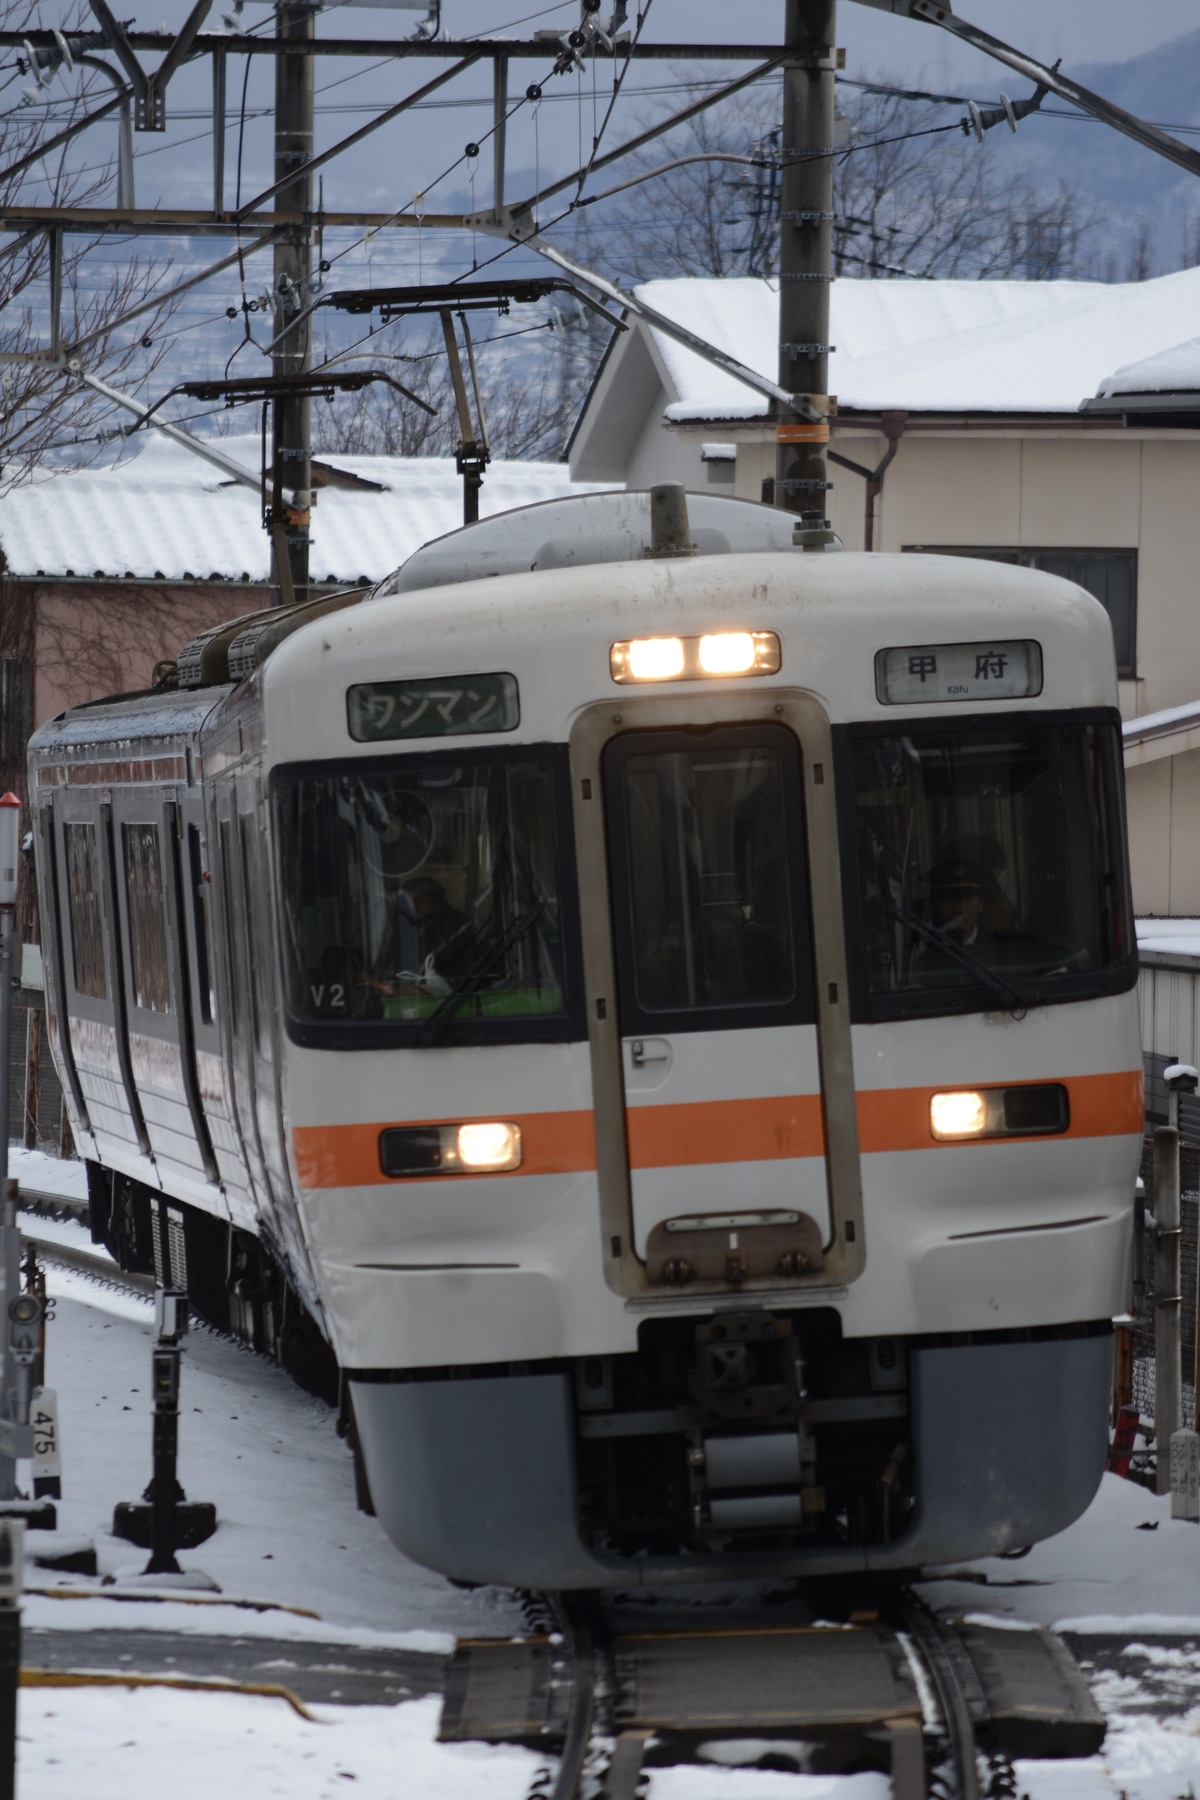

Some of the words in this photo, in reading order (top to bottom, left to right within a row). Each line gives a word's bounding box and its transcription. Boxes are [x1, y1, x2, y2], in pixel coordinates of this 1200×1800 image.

[908, 650, 1008, 683] 甲府
[368, 690, 498, 729] ワンマン
[310, 984, 346, 1008] V2
[34, 1411, 56, 1455] 475
